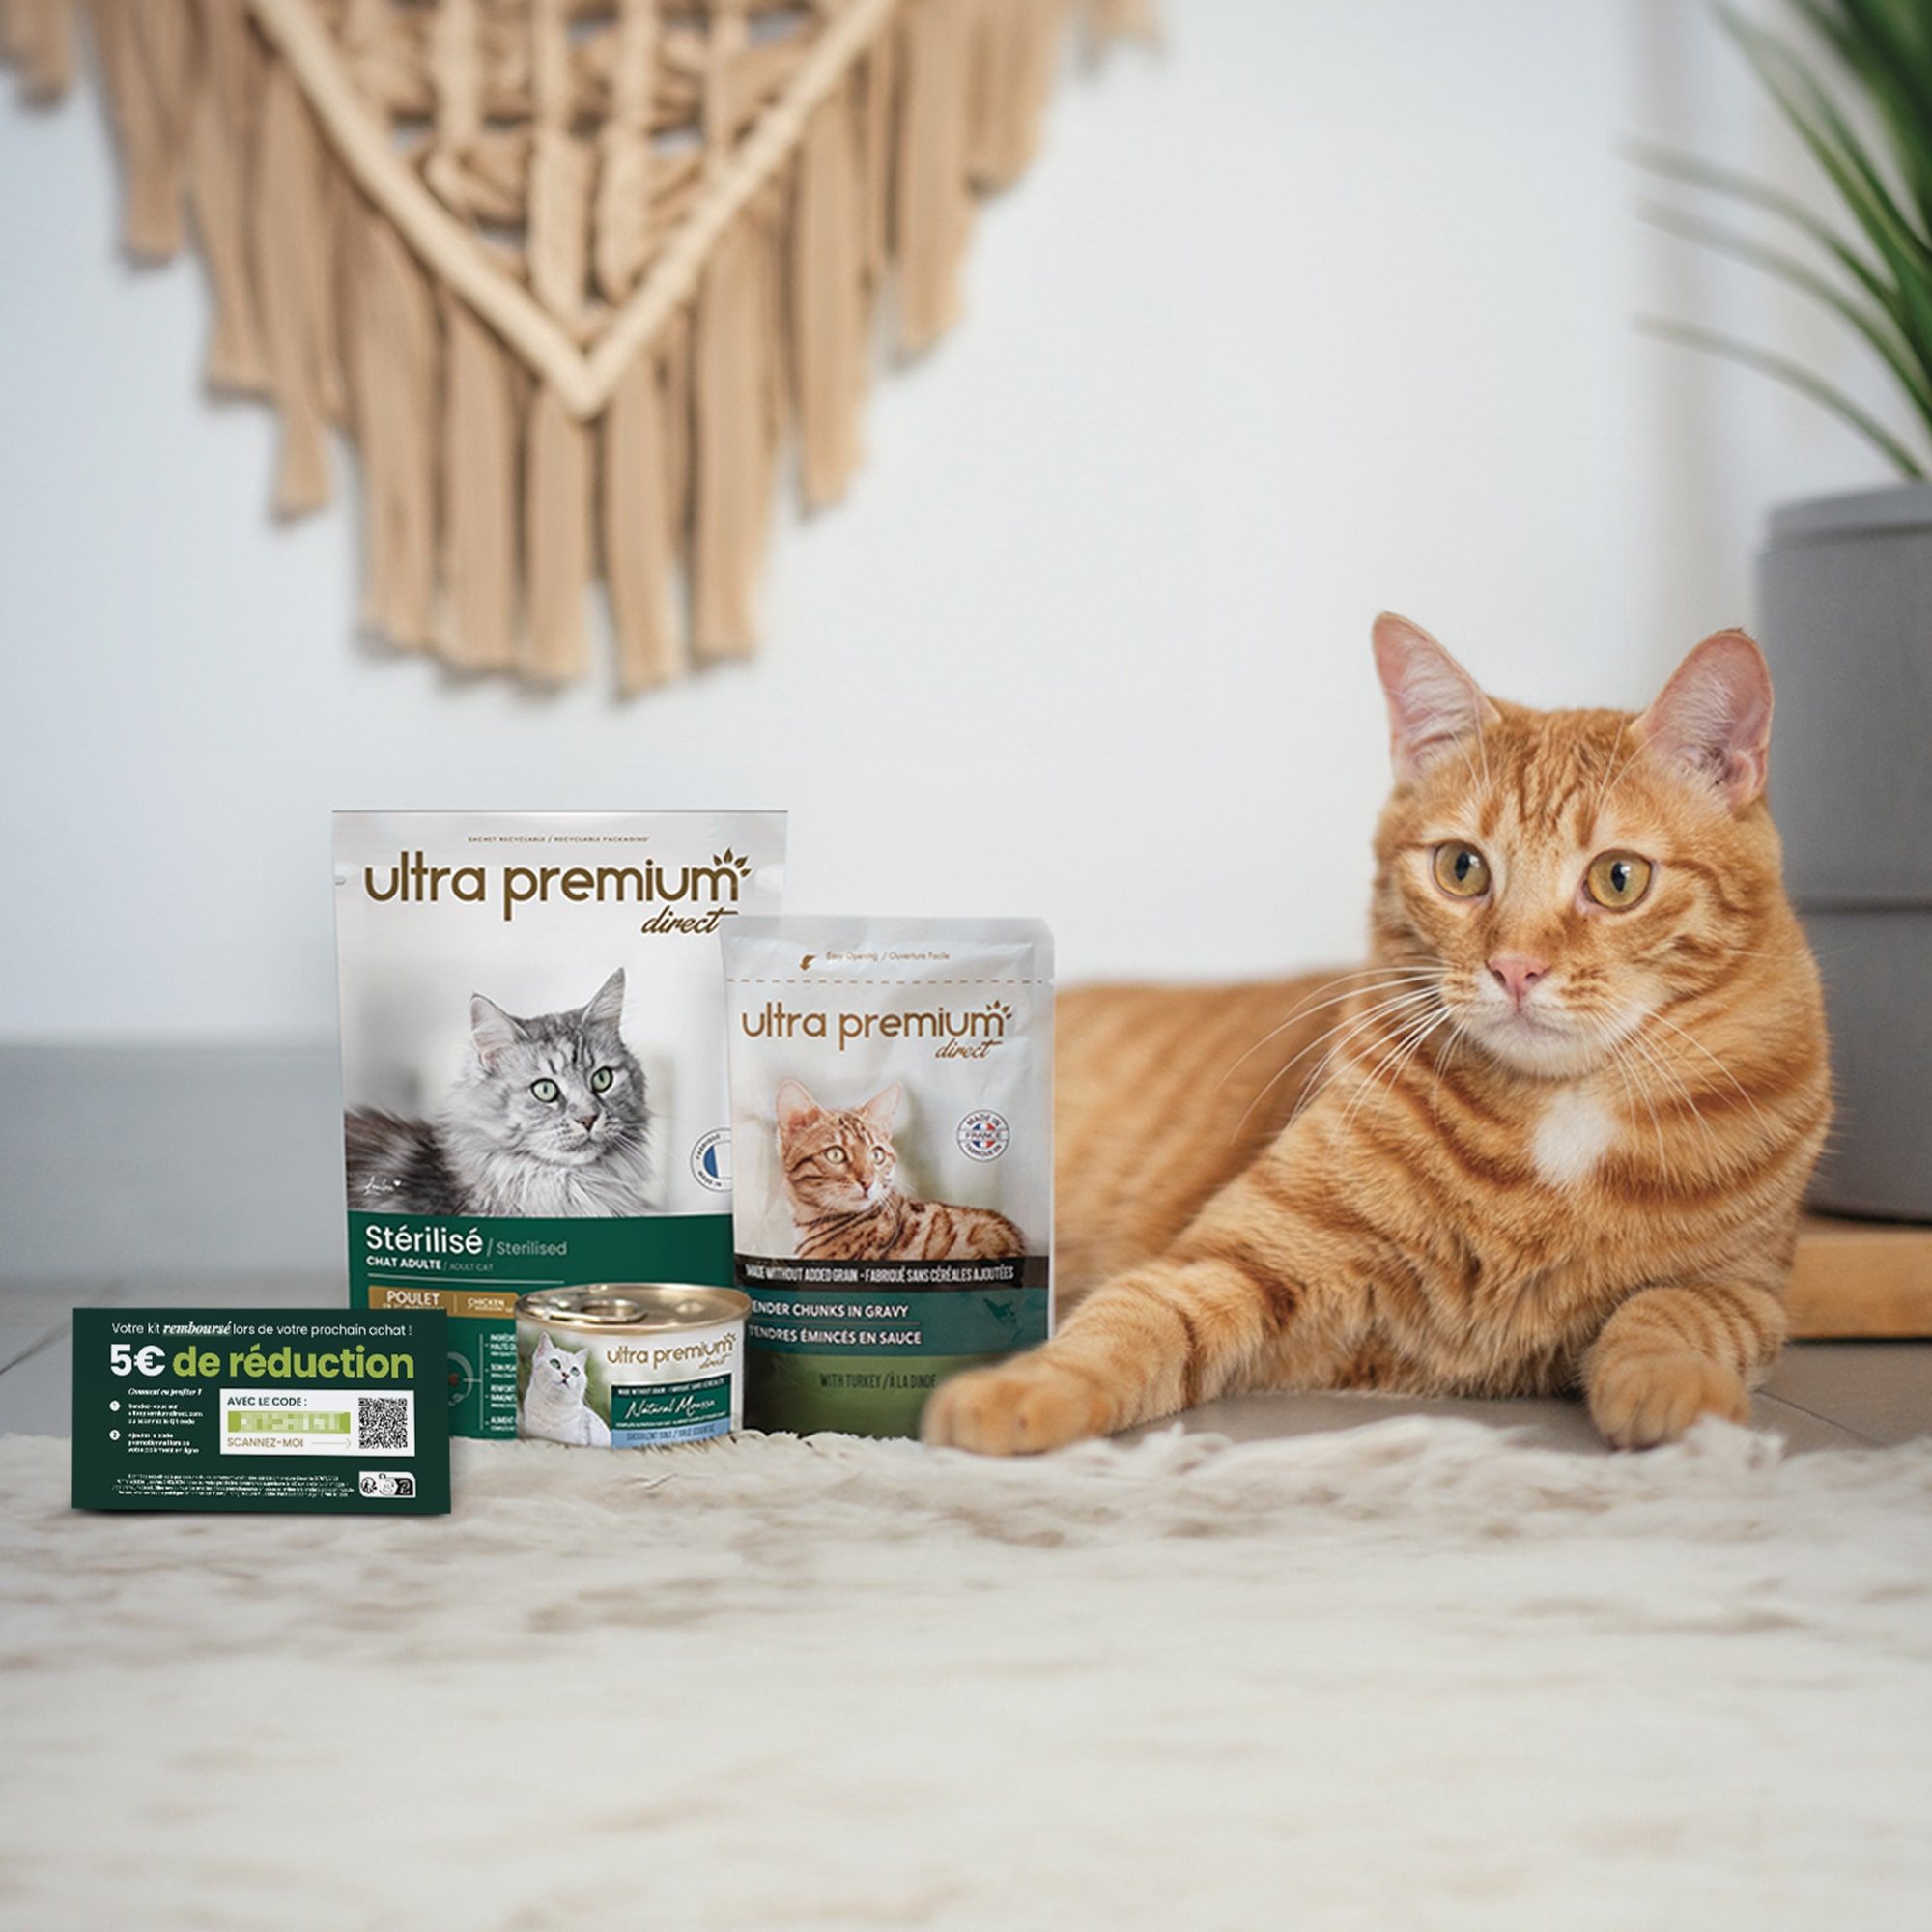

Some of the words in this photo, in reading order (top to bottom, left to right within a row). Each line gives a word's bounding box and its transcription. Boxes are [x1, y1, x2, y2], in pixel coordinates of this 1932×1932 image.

[365, 851, 485, 901] ultra
[504, 859, 738, 921] premium
[641, 905, 738, 933] direct
[742, 1002, 826, 1037] ultra
[839, 1008, 1004, 1051] premium
[935, 1039, 1003, 1059] direct
[366, 1225, 483, 1255] Stérilisé
[486, 1238, 494, 1257] /
[497, 1240, 567, 1256] Sterilised
[366, 1256, 397, 1268] CHAT
[399, 1258, 441, 1270] ADULTE
[449, 1263, 475, 1271] ADULT
[476, 1263, 494, 1272] CAT
[765, 1266, 804, 1281] WITHOUT
[805, 1268, 832, 1282] ADDED
[832, 1268, 858, 1282] GRAIN
[865, 1265, 905, 1283] FABRIQUÉ
[906, 1268, 929, 1282] SANS
[930, 1265, 972, 1282] CÉRÉALES
[973, 1264, 1013, 1280] AJOUTÉES
[386, 1290, 440, 1306] POULET
[752, 1301, 790, 1316] ENDER
[792, 1303, 845, 1318] CHUNKS
[847, 1305, 862, 1318] IN
[865, 1305, 909, 1319] GRAVY
[111, 1323, 144, 1334] Votre
[147, 1322, 160, 1334] kit
[162, 1321, 232, 1335] remboursé
[233, 1323, 255, 1335] lors
[257, 1324, 274, 1335] de
[276, 1324, 308, 1335] votre
[311, 1324, 366, 1338] prochain
[368, 1325, 407, 1336] achat
[748, 1324, 797, 1342] TENDRES
[800, 1328, 856, 1344] ÉMINCÉS
[859, 1332, 877, 1345] EN
[879, 1331, 922, 1345] SAUCE
[110, 1344, 165, 1377] 5€
[172, 1346, 221, 1378] de
[230, 1343, 414, 1378] réduction
[607, 1346, 648, 1364] ultra
[653, 1337, 732, 1369] premium
[819, 1374, 844, 1387] WITH
[845, 1374, 881, 1388] TURKEY
[227, 1397, 256, 1406] AVEC
[258, 1397, 270, 1406] LE
[271, 1397, 301, 1406] CODE
[625, 1398, 675, 1419] Natural
[227, 1437, 304, 1448] SCANNEZ-MOI
